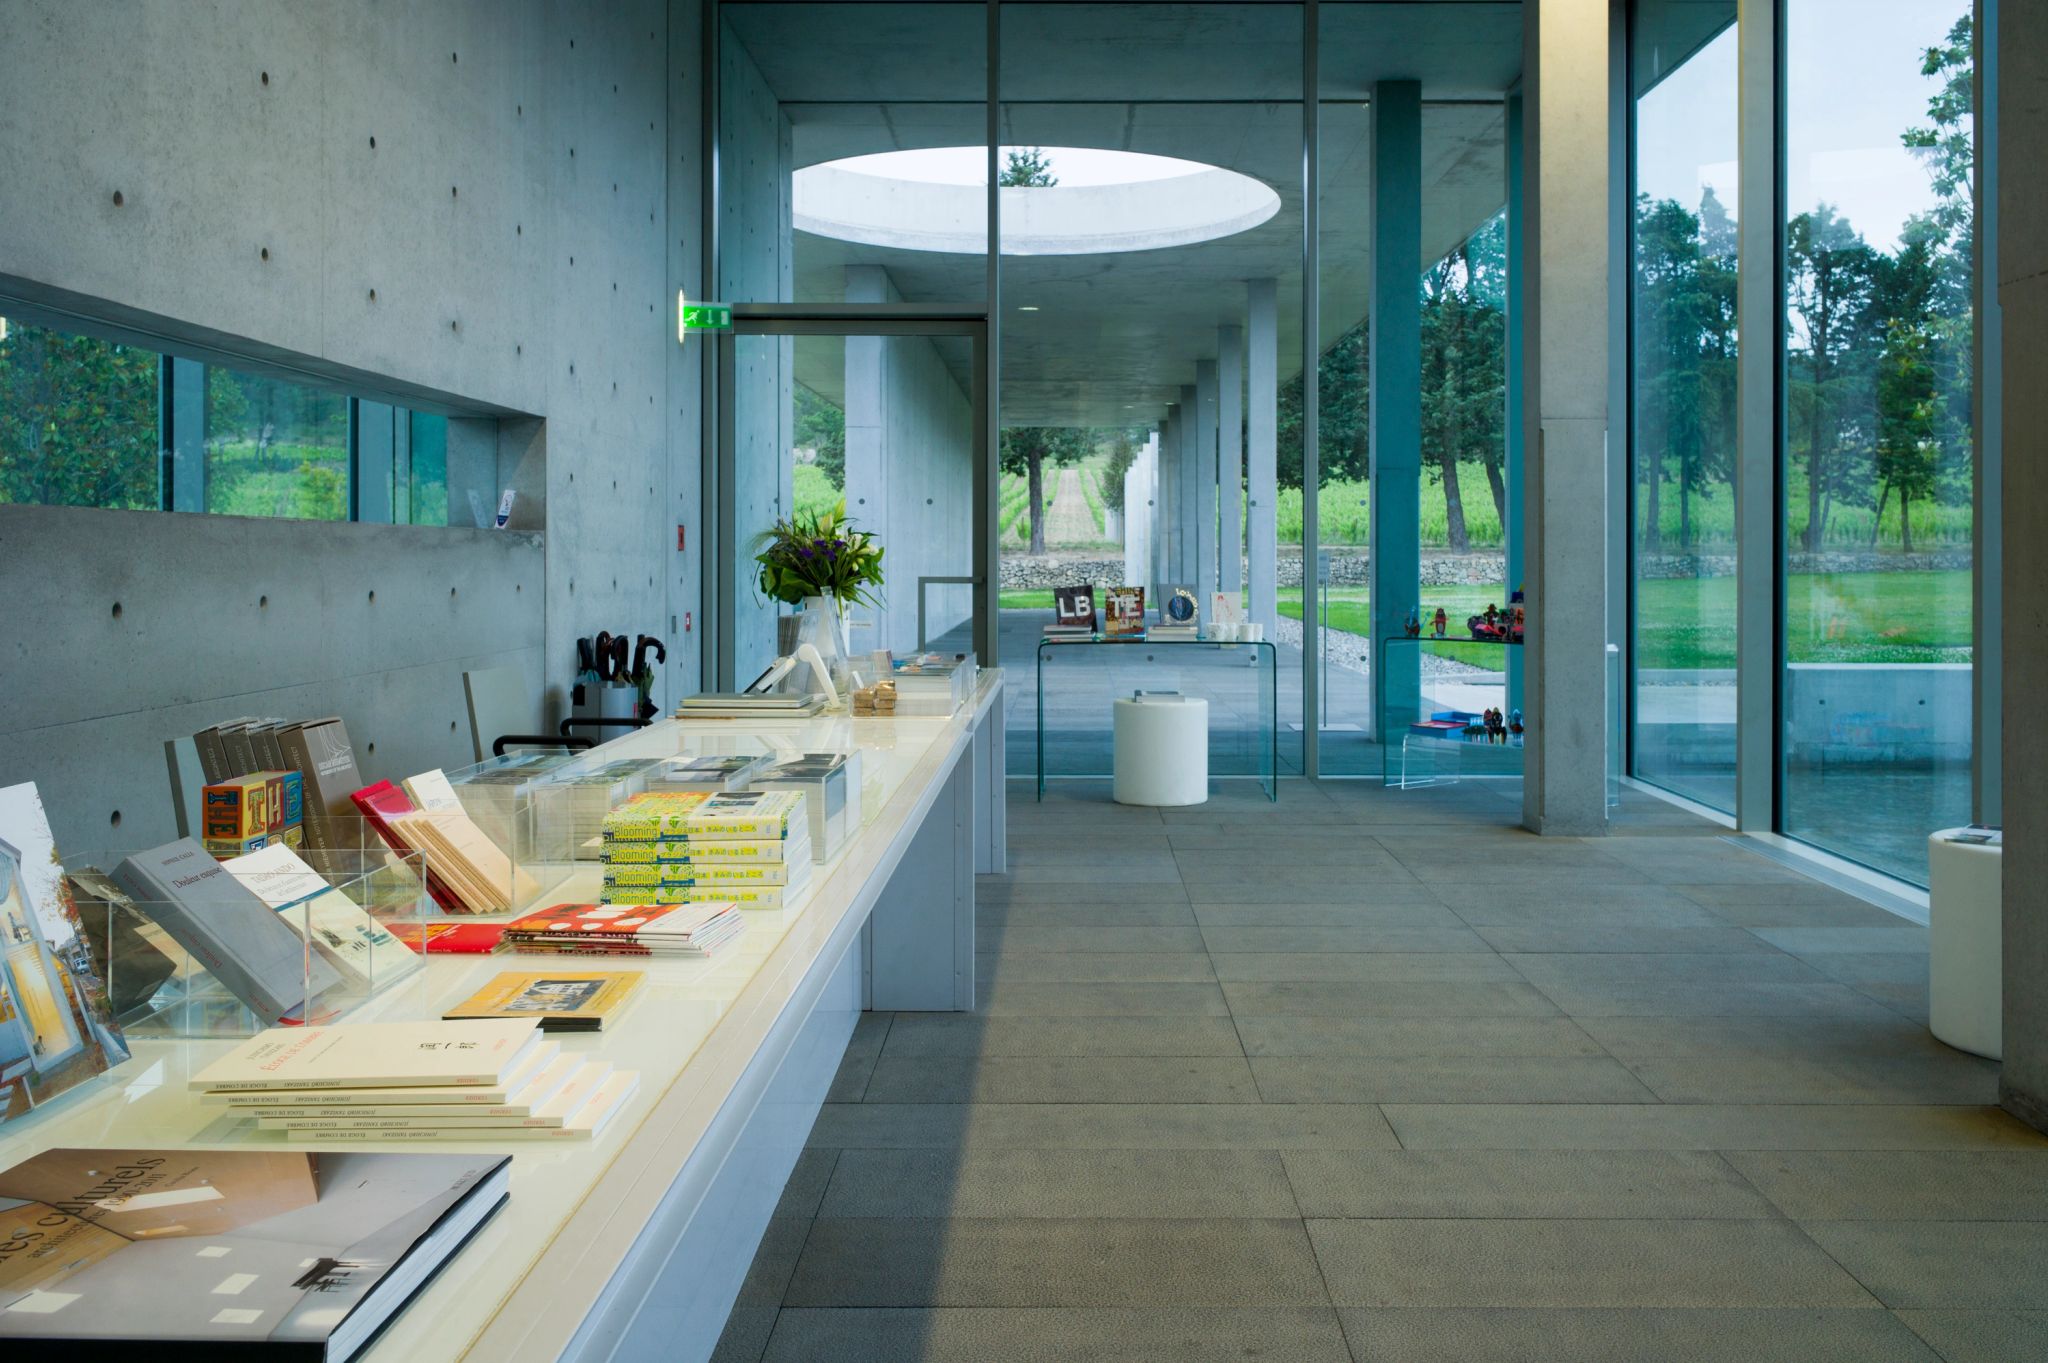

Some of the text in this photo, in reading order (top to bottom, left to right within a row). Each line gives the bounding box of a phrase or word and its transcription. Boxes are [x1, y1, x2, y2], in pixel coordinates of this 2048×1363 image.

[1059, 595, 1091, 618] LB
[208, 790, 238, 836] THE
[248, 780, 301, 836] THE
[614, 826, 658, 838] Blooming
[611, 849, 654, 860] Blooming
[616, 872, 659, 884] Blooming
[612, 894, 654, 905] Blooming
[37, 1158, 166, 1227] culturels
